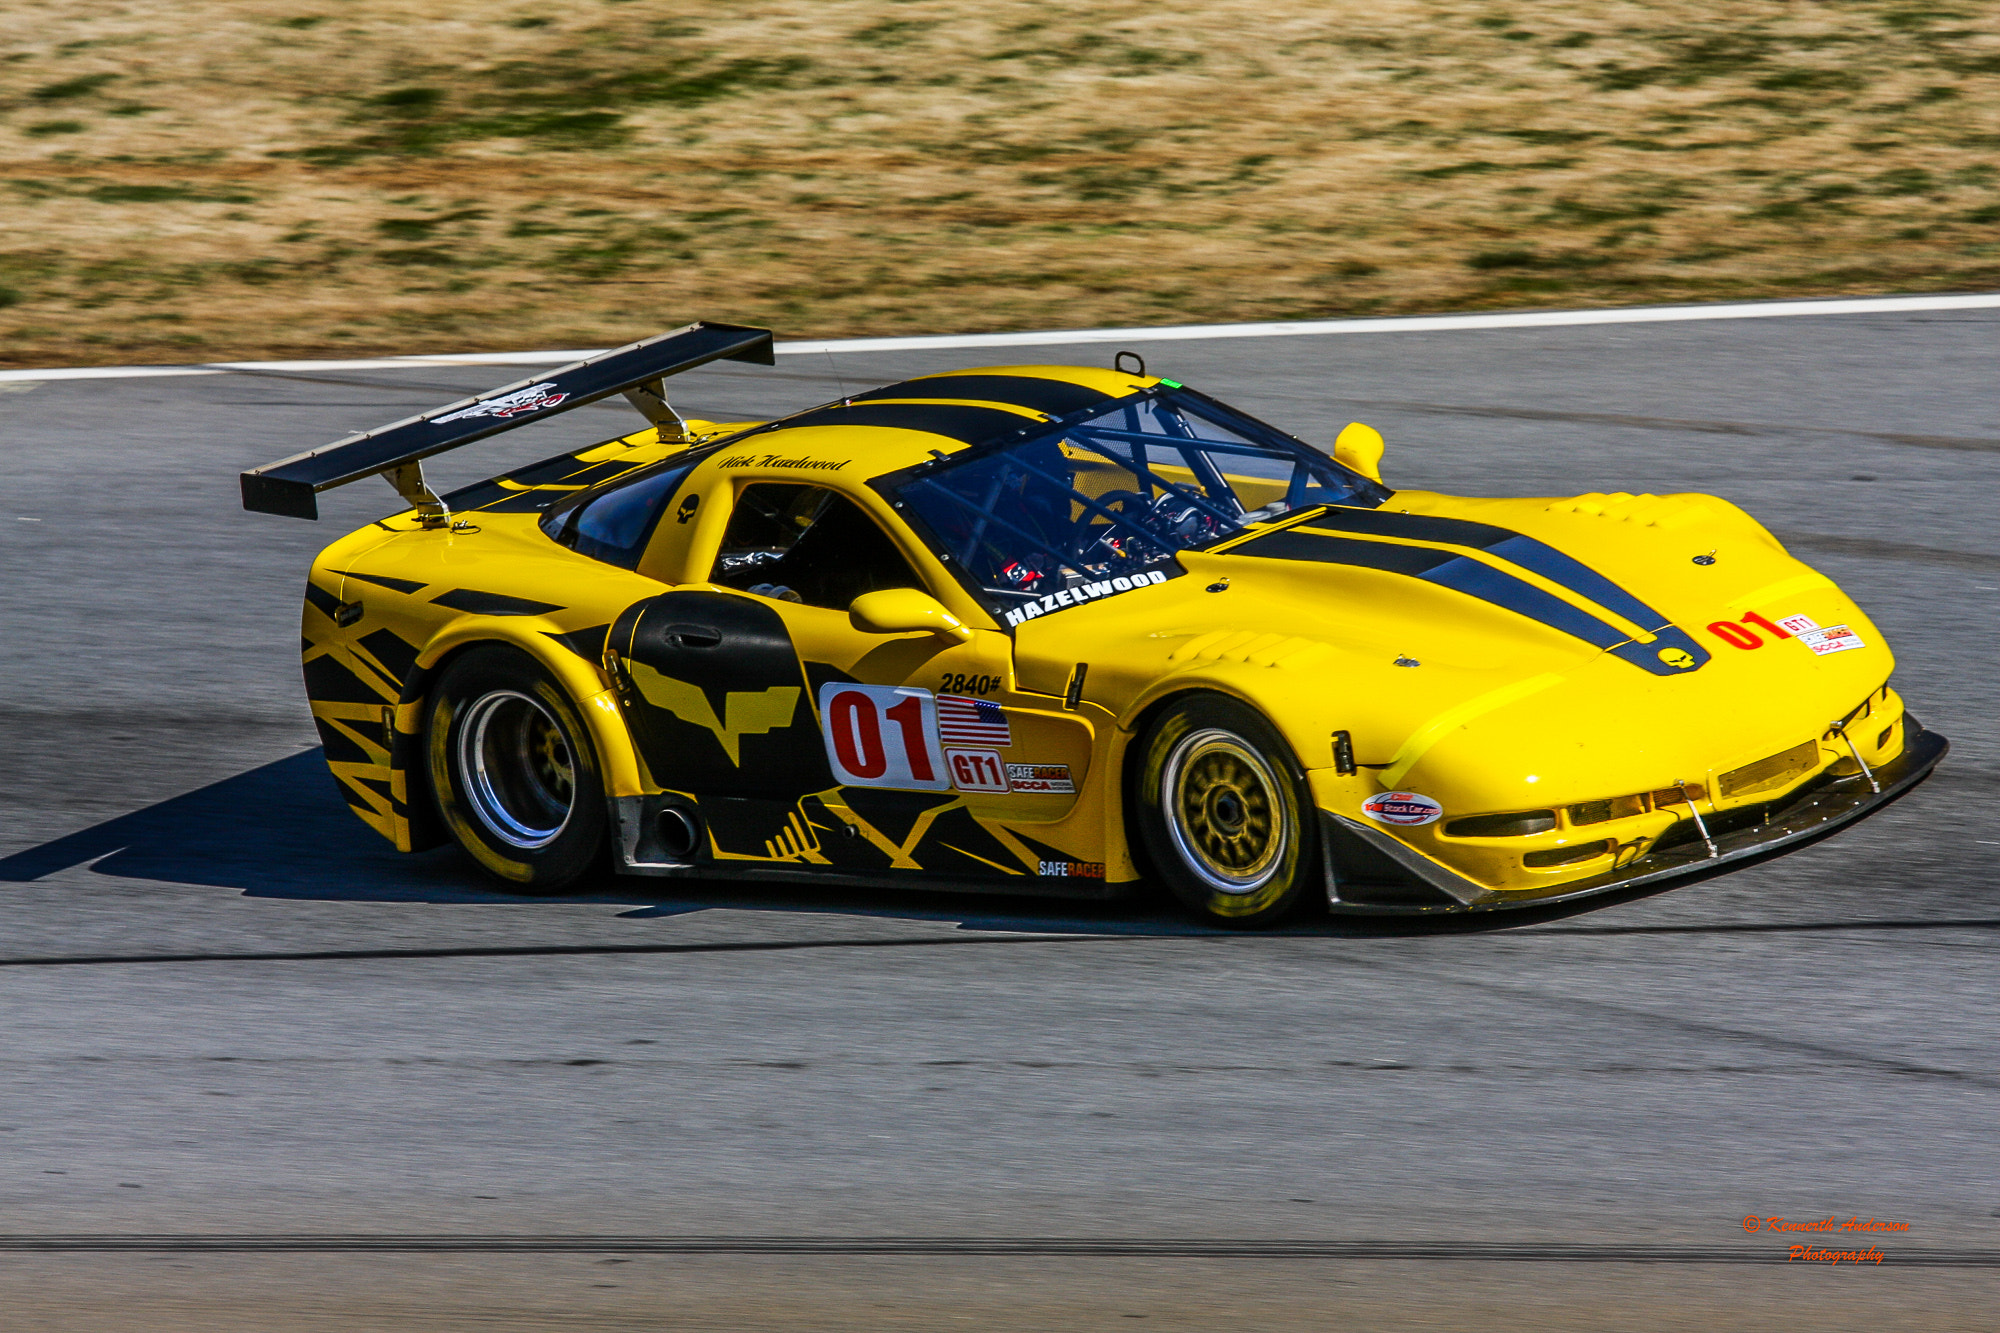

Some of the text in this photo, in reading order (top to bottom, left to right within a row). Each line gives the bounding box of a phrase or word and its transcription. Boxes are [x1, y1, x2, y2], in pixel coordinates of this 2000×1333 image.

[717, 454, 853, 471] Nick Hazelwood
[1004, 570, 1168, 627] HAZELWOOD
[1706, 611, 1792, 650] 01
[1784, 617, 1814, 632] GT1
[939, 673, 1002, 695] 2840#
[829, 690, 936, 781] 01
[952, 754, 1003, 786] GT1
[1009, 766, 1070, 779] SAFERACER
[1011, 780, 1052, 790] SCCA
[1383, 804, 1407, 813] Stock
[1039, 861, 1105, 878] SAFERACER
